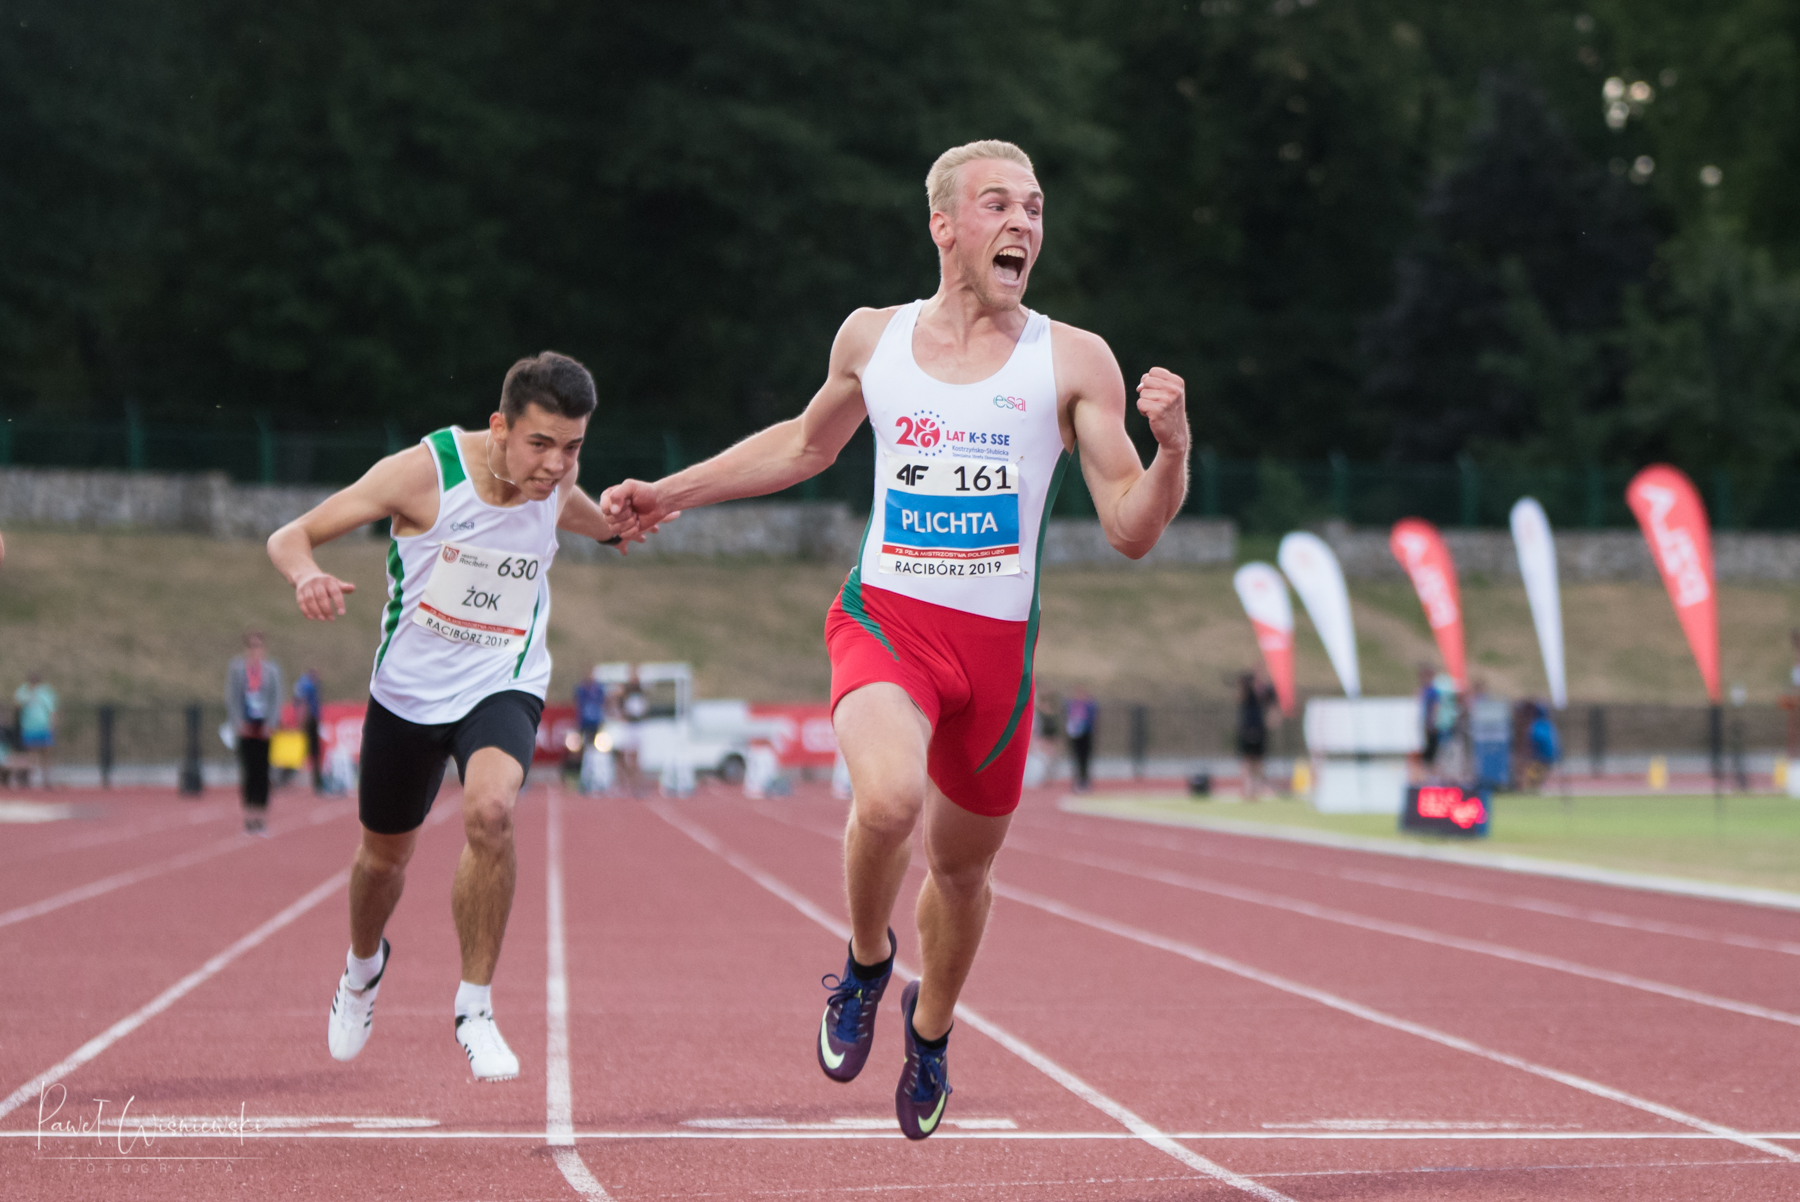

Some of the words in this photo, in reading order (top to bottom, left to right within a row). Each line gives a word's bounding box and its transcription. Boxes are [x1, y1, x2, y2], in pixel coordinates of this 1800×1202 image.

[946, 430, 966, 443] LAT
[969, 432, 988, 444] K-S
[990, 434, 1011, 446] SSE
[896, 464, 930, 486] 4F
[953, 465, 1012, 492] 161
[901, 509, 999, 535] PLICHTA
[497, 557, 539, 581] 630
[895, 560, 965, 576] RACIBÓRZ
[969, 561, 1002, 575] 2019
[461, 585, 502, 611] ŻOK
[426, 617, 483, 645] RACIBÓRZ
[484, 635, 510, 648] 2019
